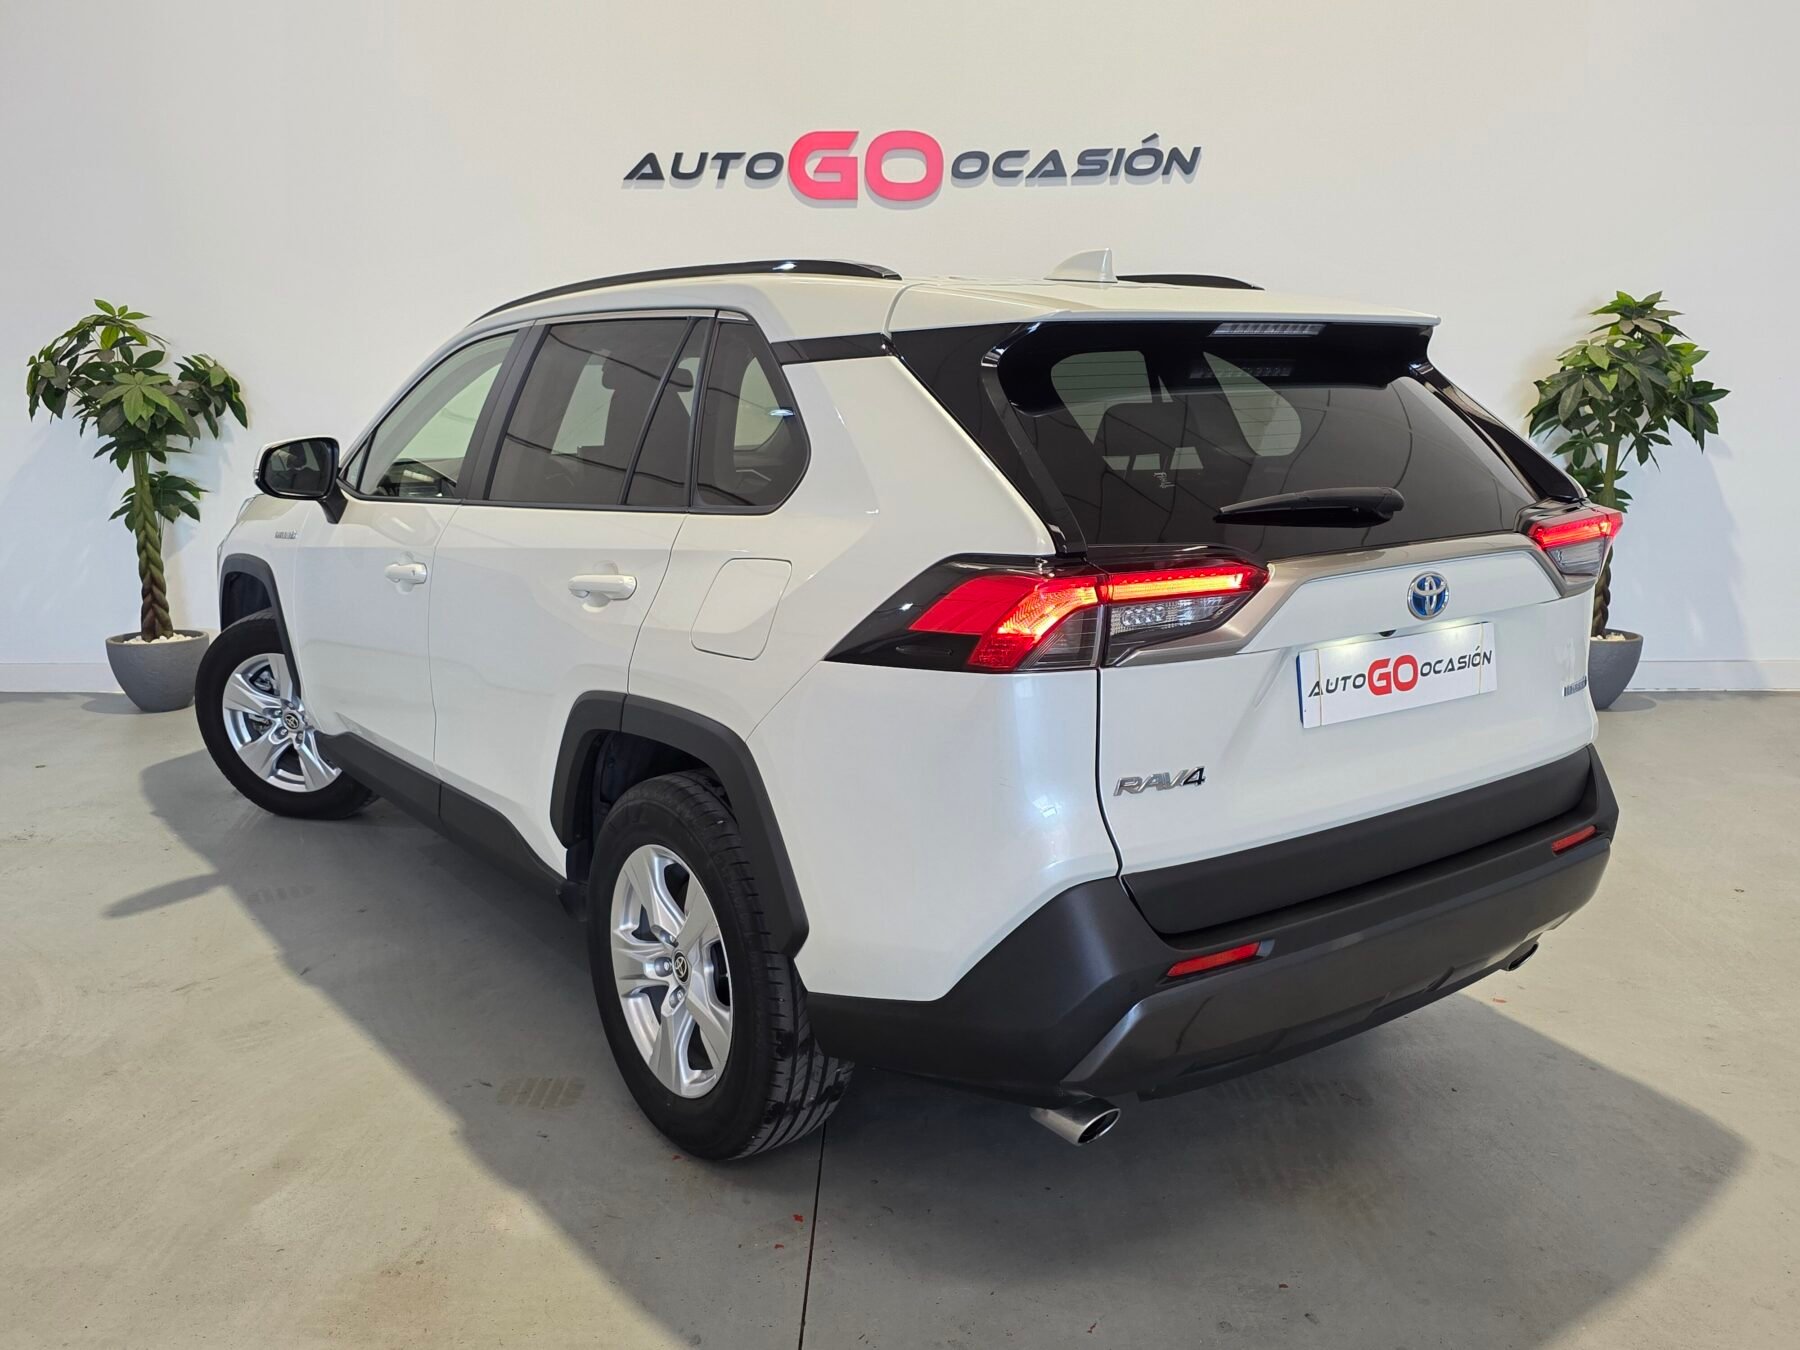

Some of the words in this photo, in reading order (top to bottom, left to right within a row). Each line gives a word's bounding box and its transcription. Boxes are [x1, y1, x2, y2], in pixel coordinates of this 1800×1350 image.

[951, 133, 1202, 180] OCASIÓN
[1420, 645, 1492, 678] OCASIÓN
[1113, 766, 1206, 796] RAV4
